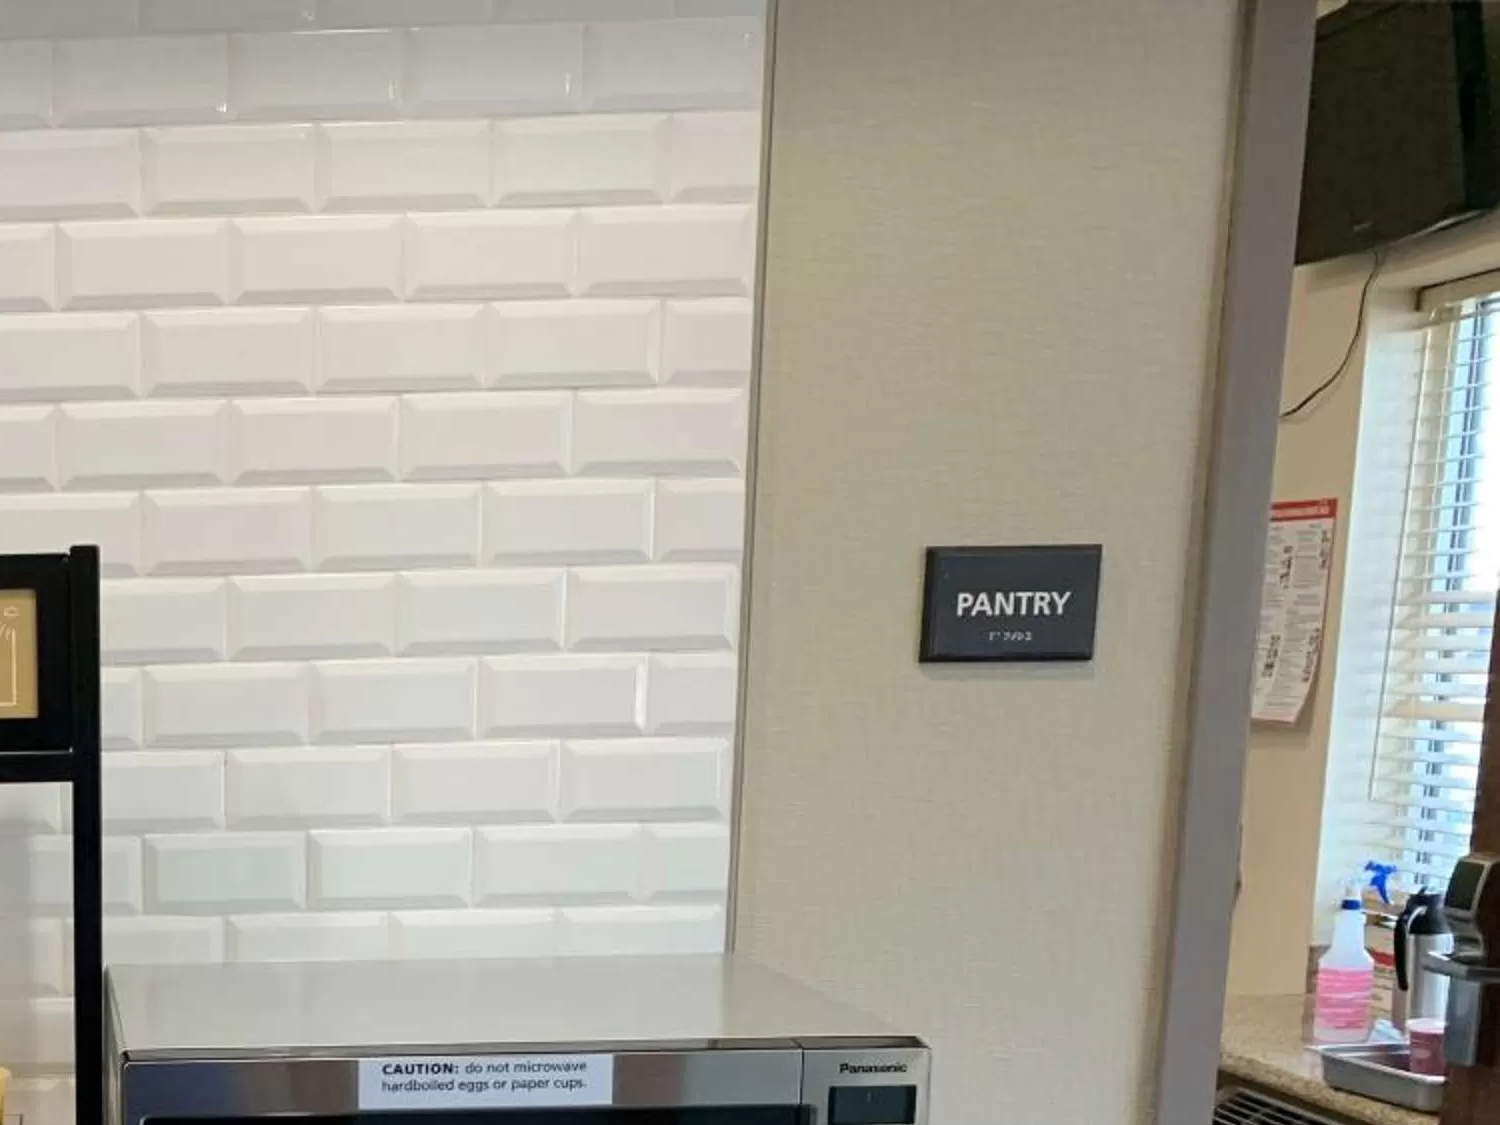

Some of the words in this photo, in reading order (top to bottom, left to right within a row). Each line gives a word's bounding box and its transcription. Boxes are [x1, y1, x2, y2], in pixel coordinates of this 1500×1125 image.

[956, 591, 1072, 617] PANTRY
[381, 1062, 459, 1076] CAUTION:
[465, 1061, 483, 1074] do
[487, 1062, 510, 1074] not
[513, 1060, 587, 1073] microwave
[839, 1062, 909, 1074] Panasonic
[381, 1079, 454, 1093] hardboiled
[458, 1081, 490, 1093] eggs
[493, 1080, 508, 1090] or
[511, 1079, 549, 1092] paper
[553, 1078, 587, 1090] cups.
